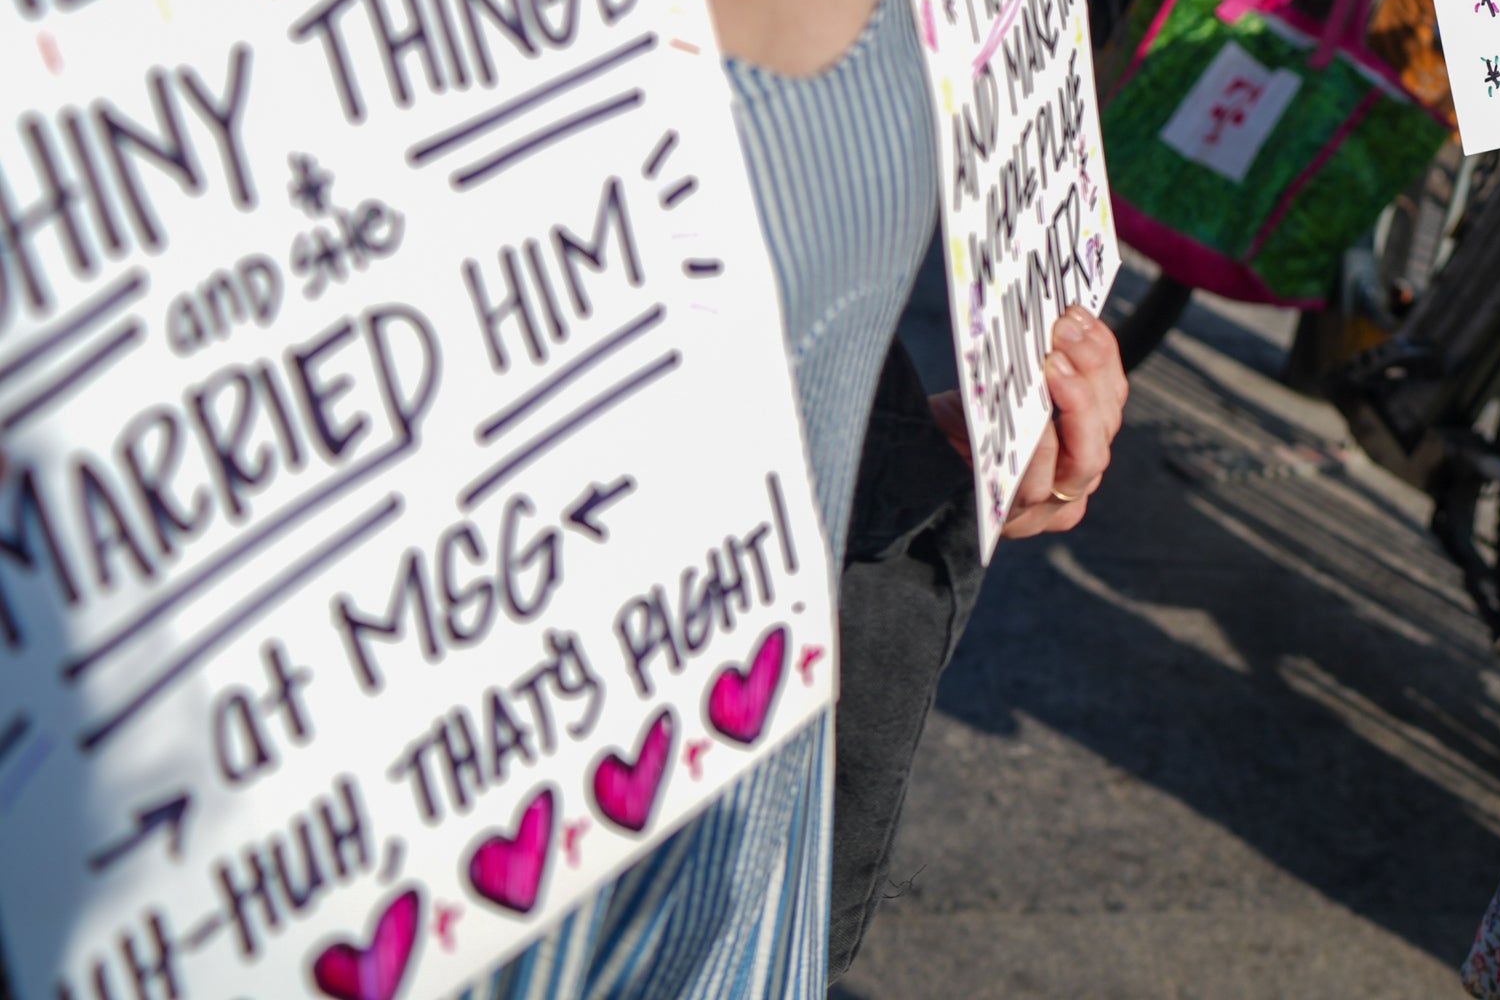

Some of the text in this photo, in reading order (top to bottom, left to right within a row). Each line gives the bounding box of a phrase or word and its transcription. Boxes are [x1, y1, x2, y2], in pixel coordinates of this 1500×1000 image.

[0, 40, 259, 320] HINY
[0, 174, 646, 651] MARRIED HIM
[330, 493, 565, 697] MSG
[612, 469, 806, 701] RIGHT!
